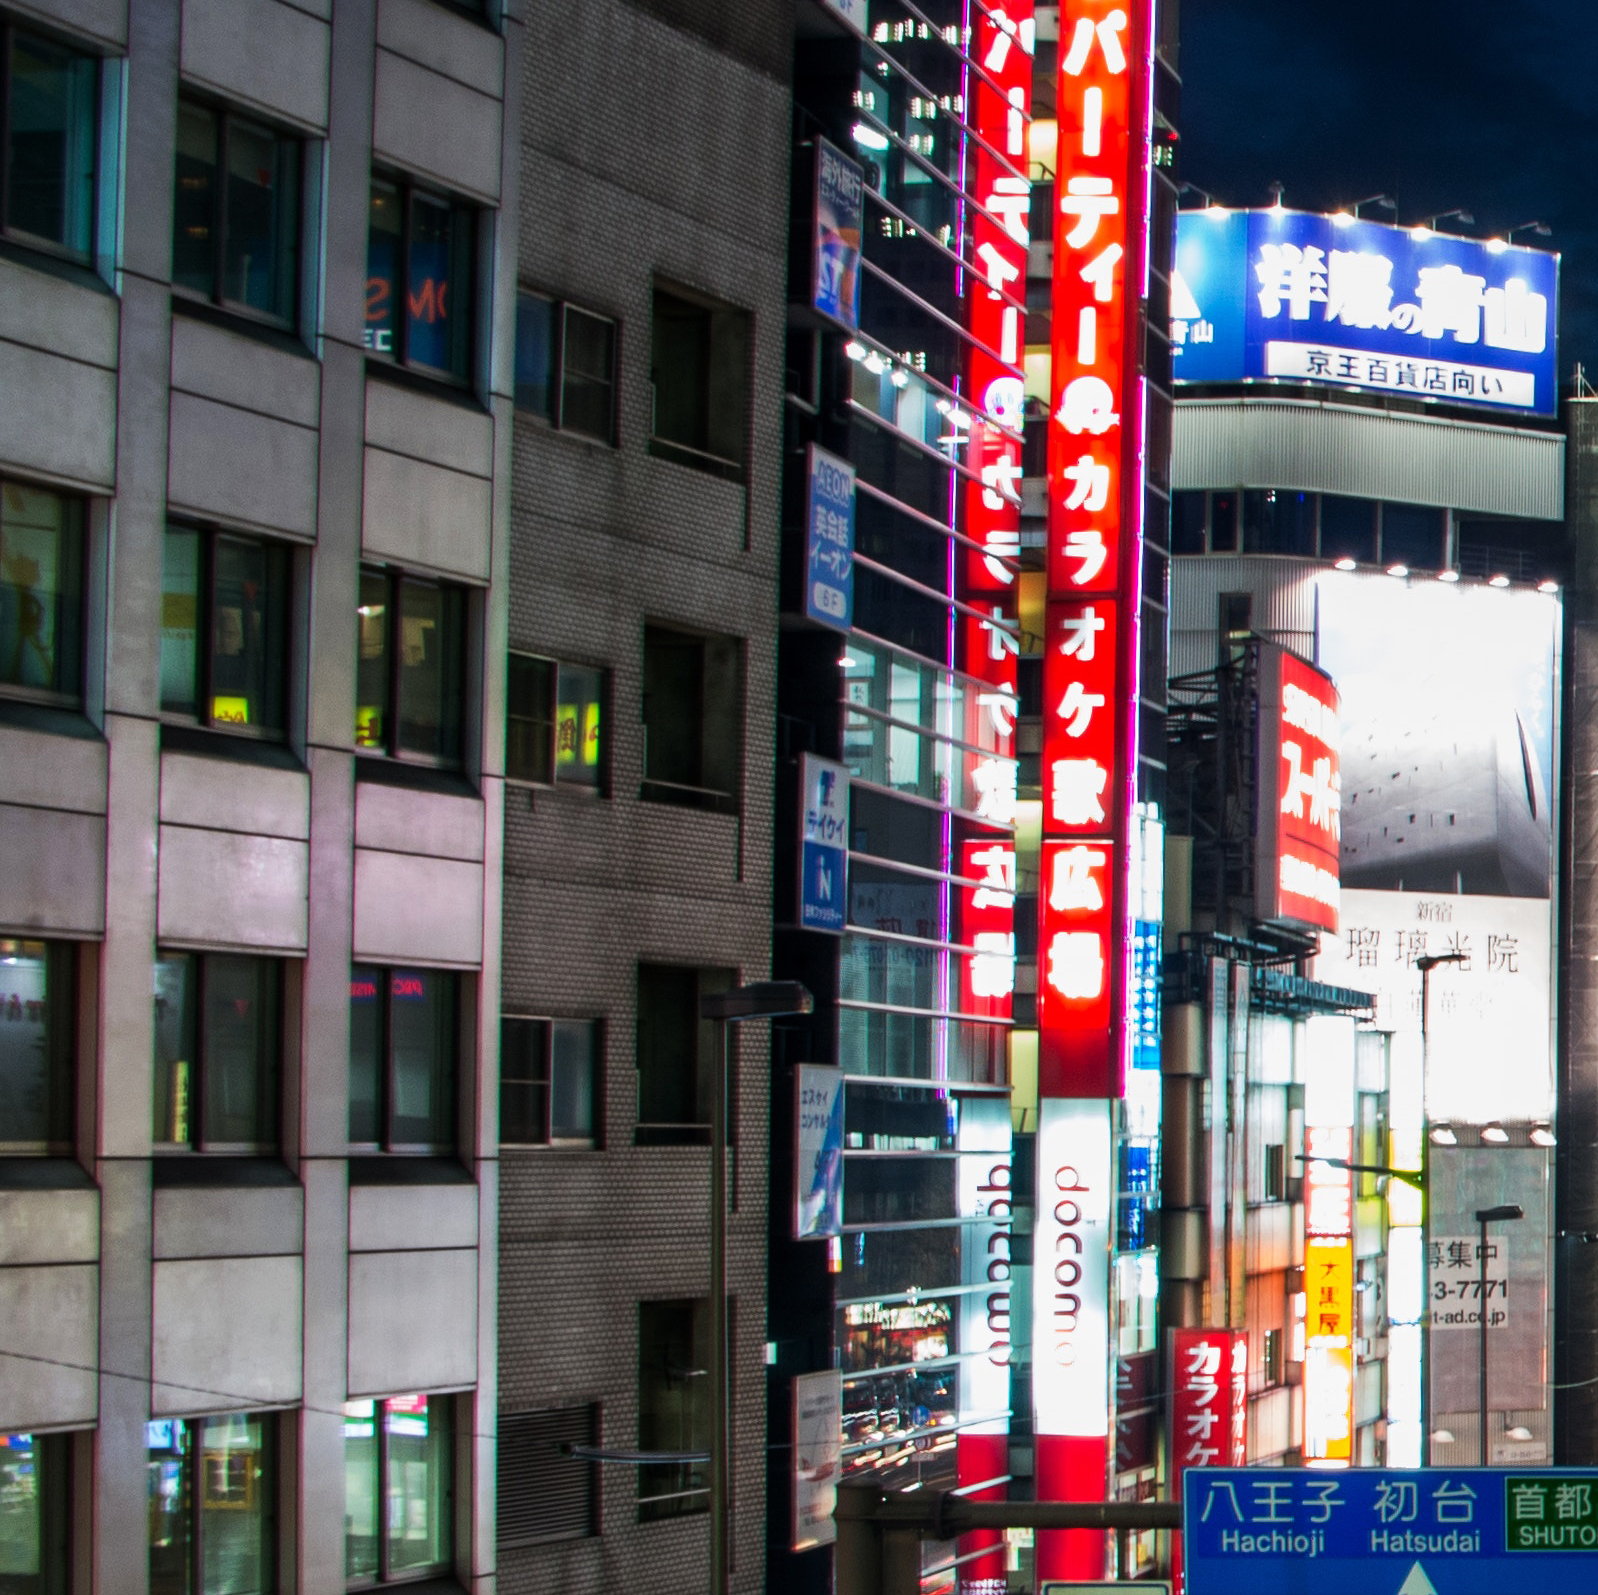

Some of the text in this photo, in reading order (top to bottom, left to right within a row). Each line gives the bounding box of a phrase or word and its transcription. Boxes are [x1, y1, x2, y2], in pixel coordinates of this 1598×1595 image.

[1255, 243, 1547, 353] 洋服の青山
[1307, 349, 1503, 395] 京王百貨店向い
[817, 460, 850, 501] AEON
[815, 505, 849, 548] 英会話
[811, 541, 851, 580] イーオン
[1416, 900, 1453, 923] 新宿
[1346, 927, 1519, 974] 瑠璃光院
[1054, 1165, 1090, 1367] docomo
[1319, 1260, 1341, 1334] 大黒屋
[1201, 1481, 1347, 1524] 八王子
[1373, 1481, 1478, 1524] 初台
[1221, 1529, 1325, 1558] Hachioji
[1370, 1529, 1481, 1554] Hatsudai
